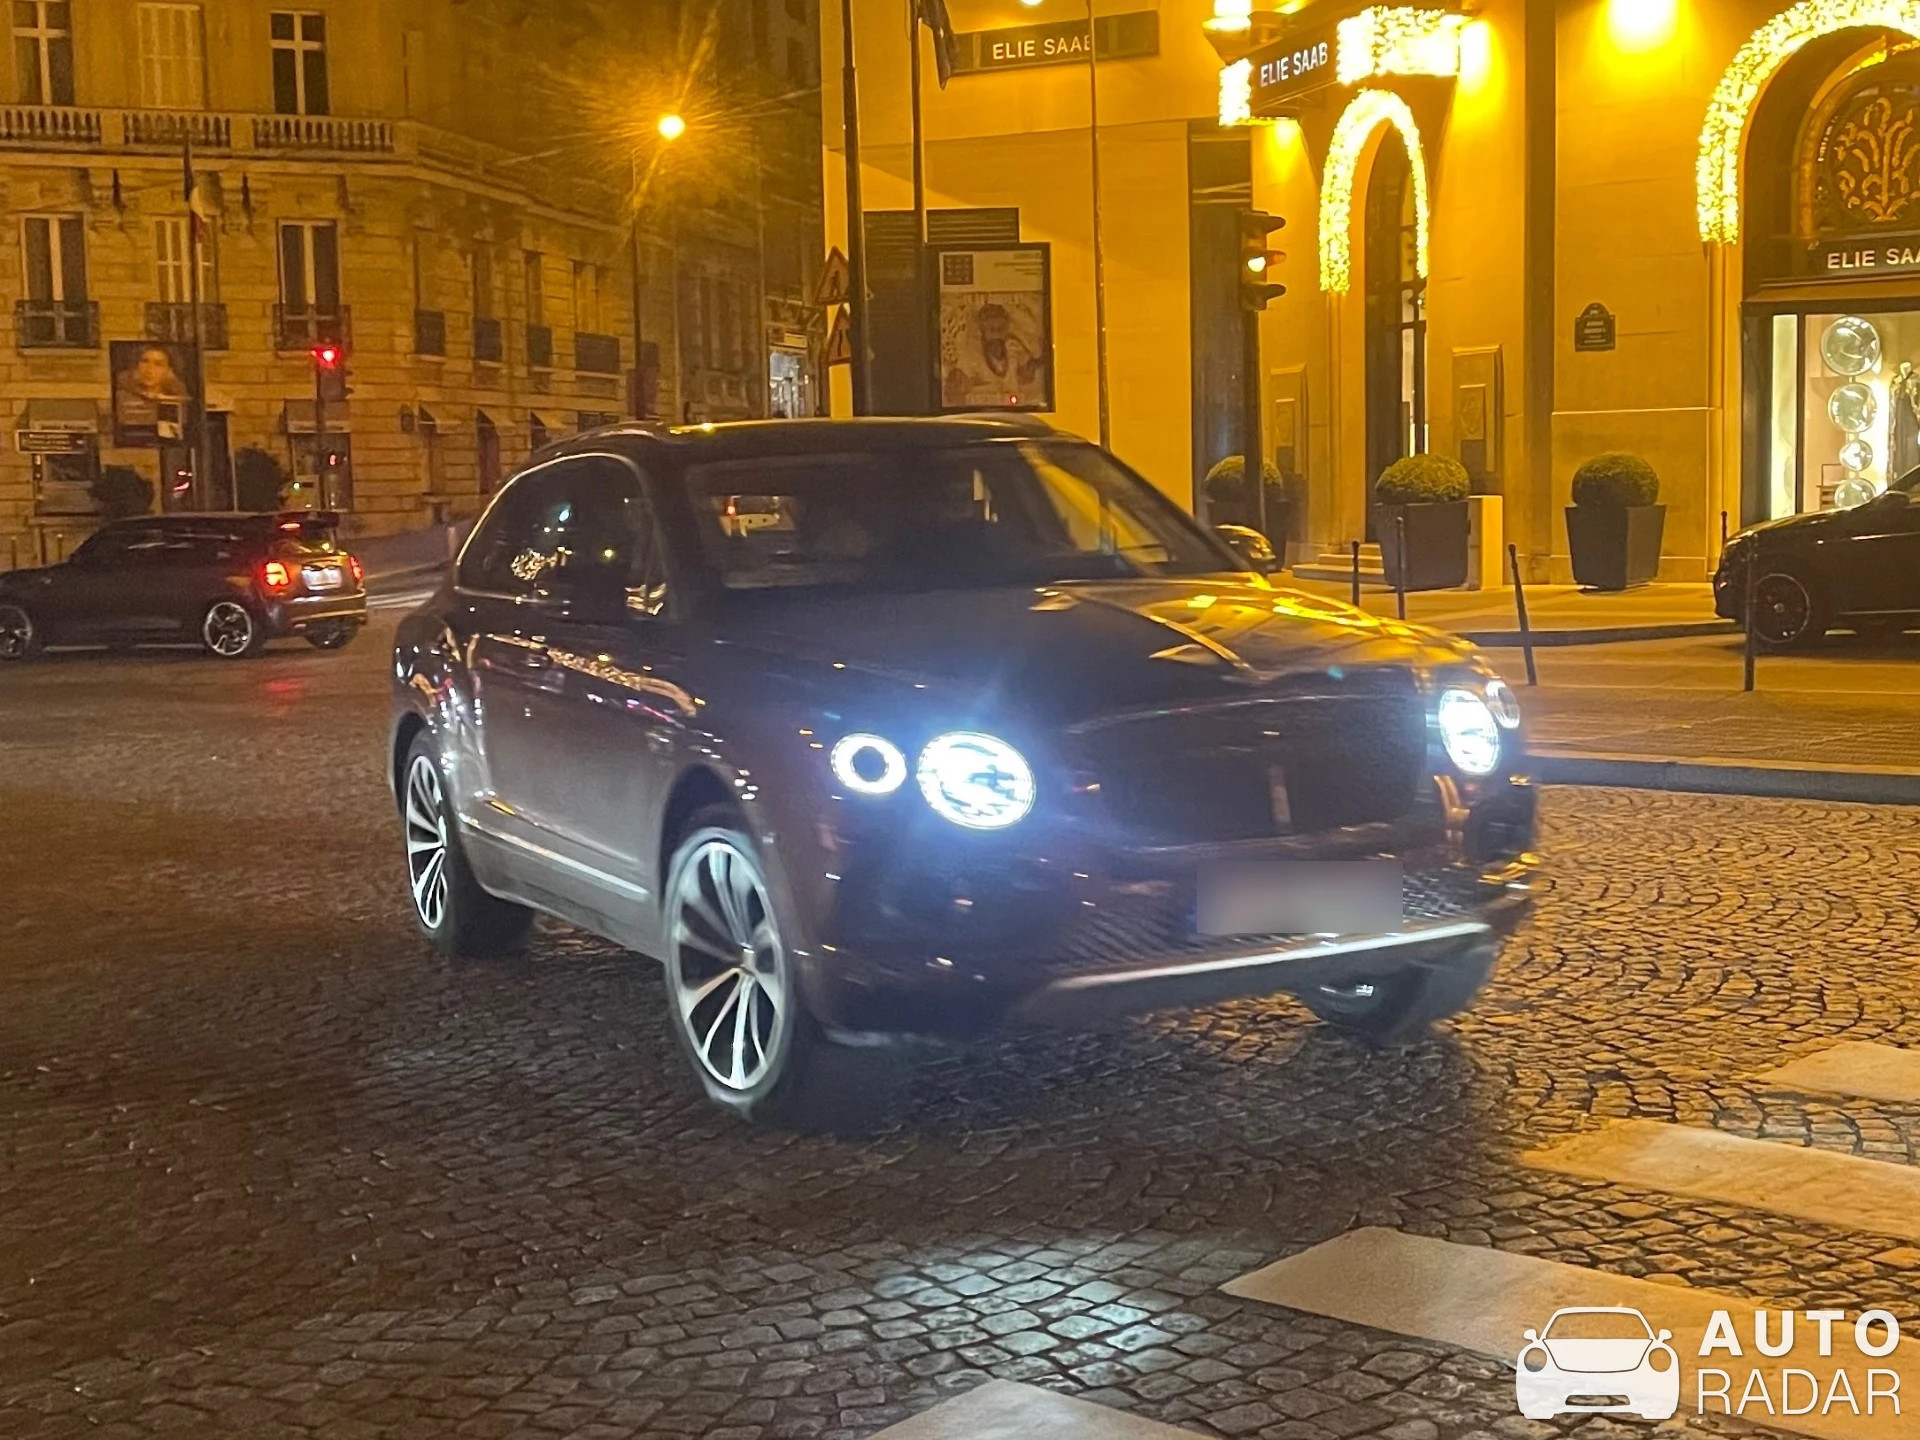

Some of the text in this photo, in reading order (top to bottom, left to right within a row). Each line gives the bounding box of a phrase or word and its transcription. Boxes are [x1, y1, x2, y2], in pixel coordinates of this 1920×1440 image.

[993, 40, 1036, 60] ELIE
[1260, 42, 1328, 88] ELIE SAAB
[1827, 250, 1875, 269] ELIE
